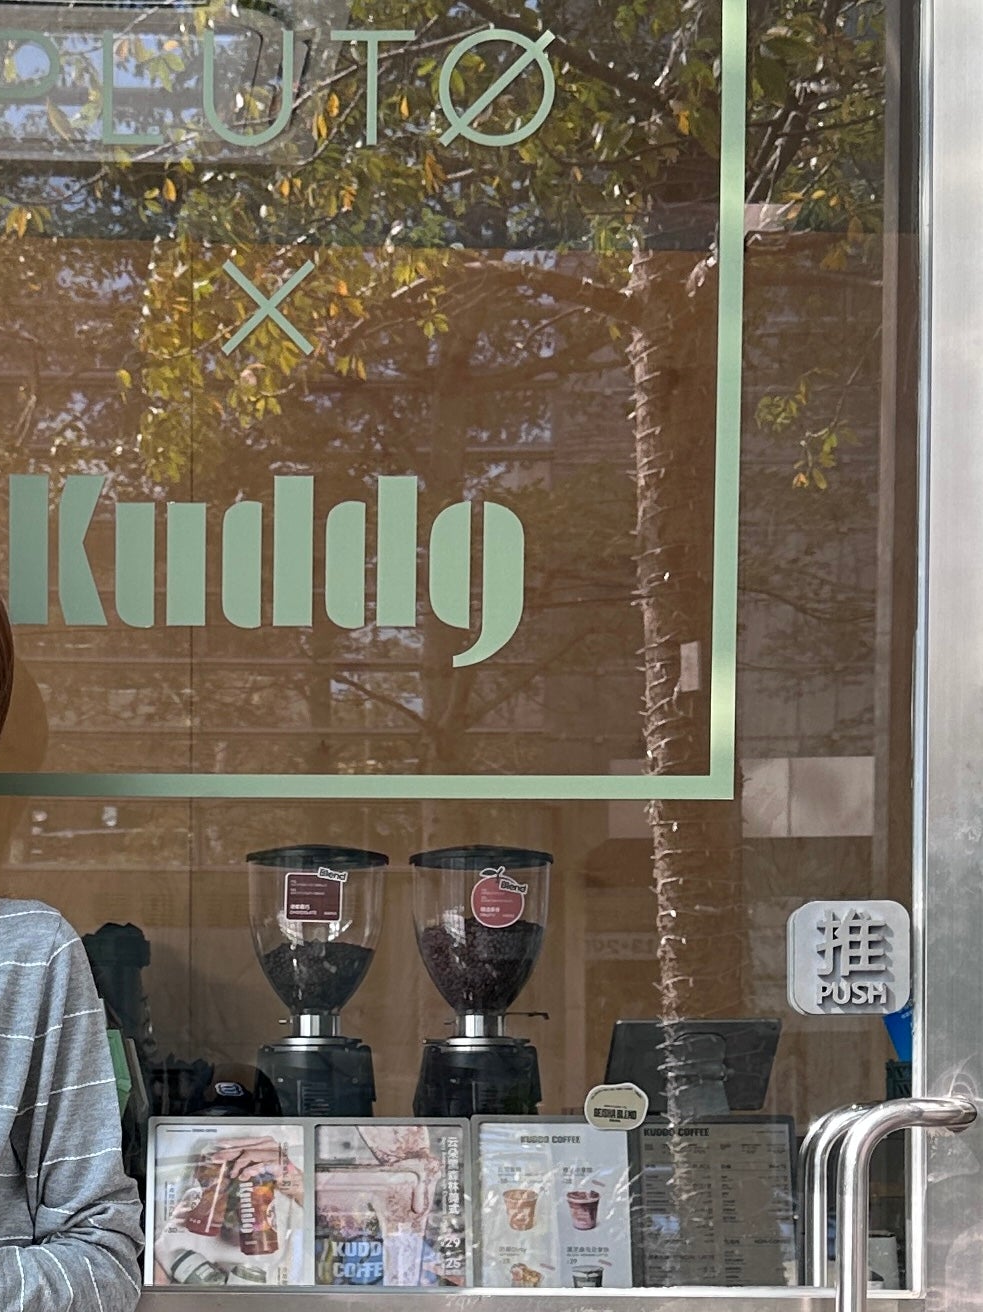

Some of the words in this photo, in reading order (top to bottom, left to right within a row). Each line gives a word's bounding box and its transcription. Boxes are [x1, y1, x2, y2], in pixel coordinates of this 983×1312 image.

[320, 868, 346, 881] Blend
[500, 880, 527, 893] Blend
[816, 907, 889, 978] 推
[816, 979, 888, 1006] PUSH
[678, 1127, 710, 1137] COFFEE
[551, 1135, 581, 1144] COFFEE
[332, 1241, 384, 1258] KUDD
[332, 1262, 384, 1278] COFFE
